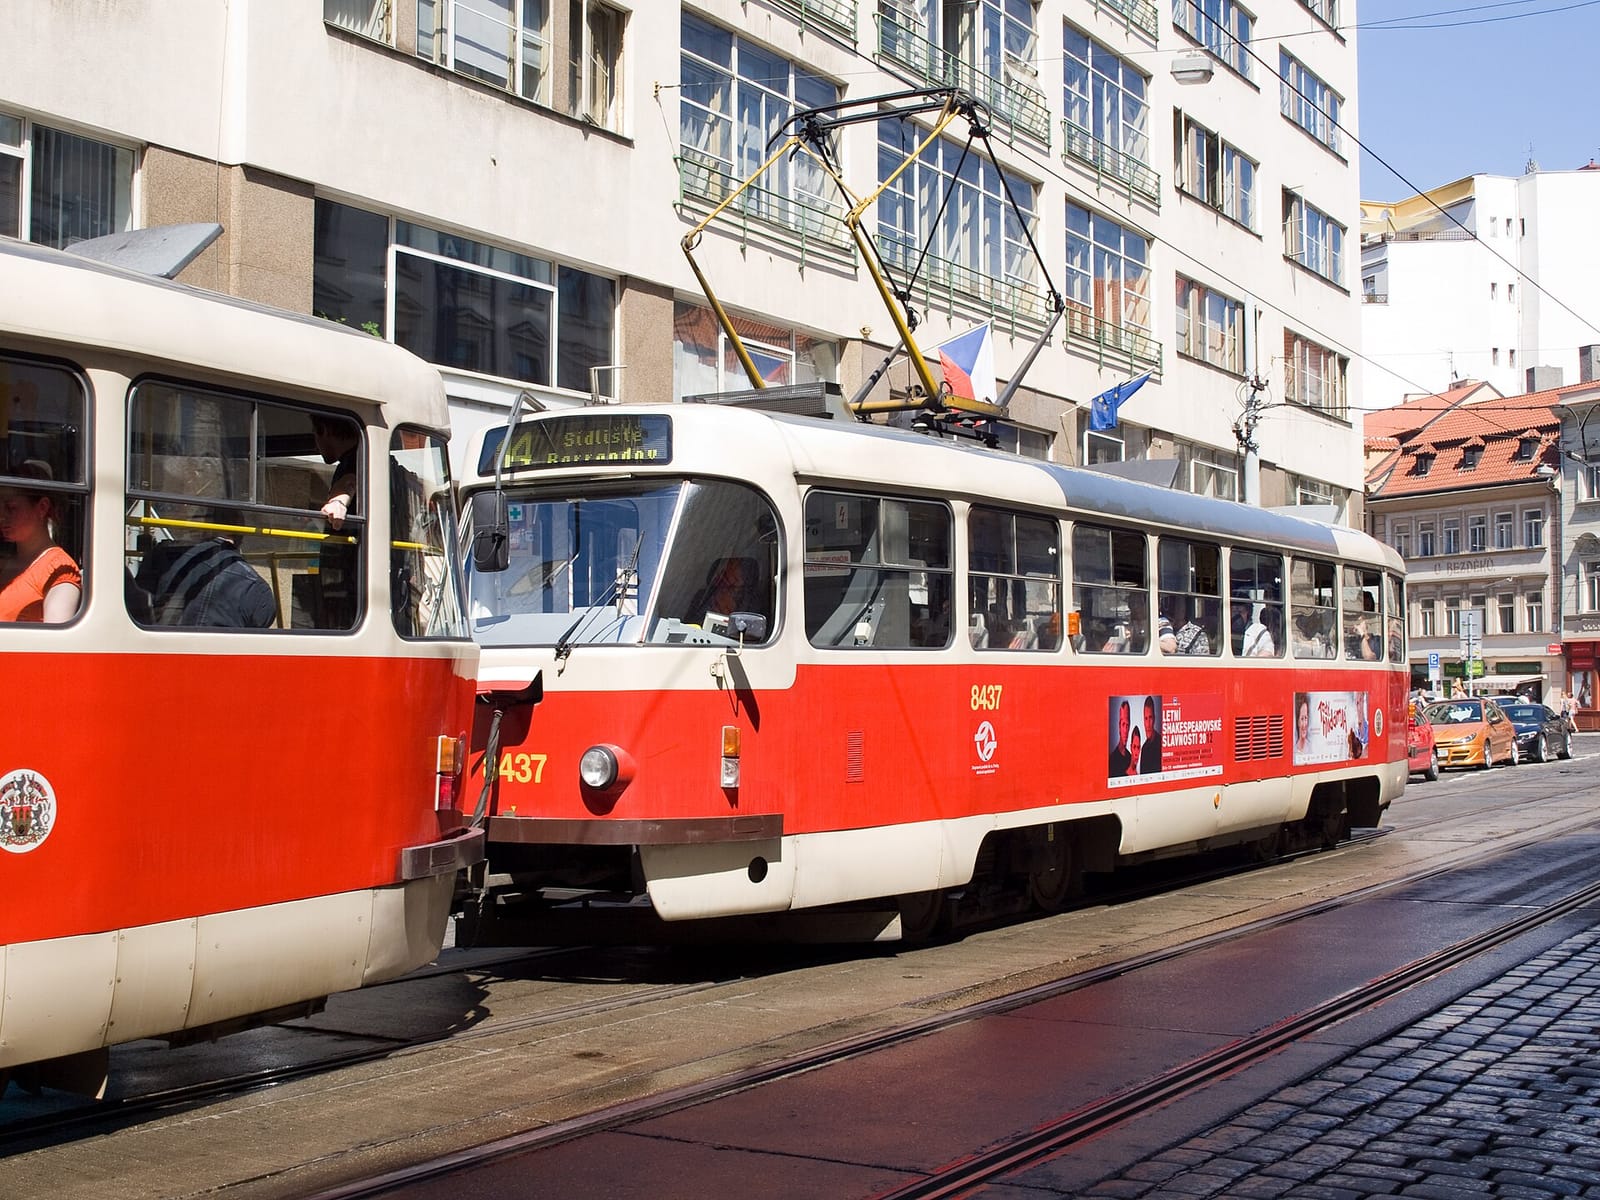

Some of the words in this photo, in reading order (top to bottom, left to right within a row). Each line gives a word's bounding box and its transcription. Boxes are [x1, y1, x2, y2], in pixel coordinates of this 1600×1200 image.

[970, 684, 1003, 711] 8437
[1162, 717, 1222, 735] SHAKESPEAROVSKÉ
[1162, 733, 1198, 747] SLAVNOSTI
